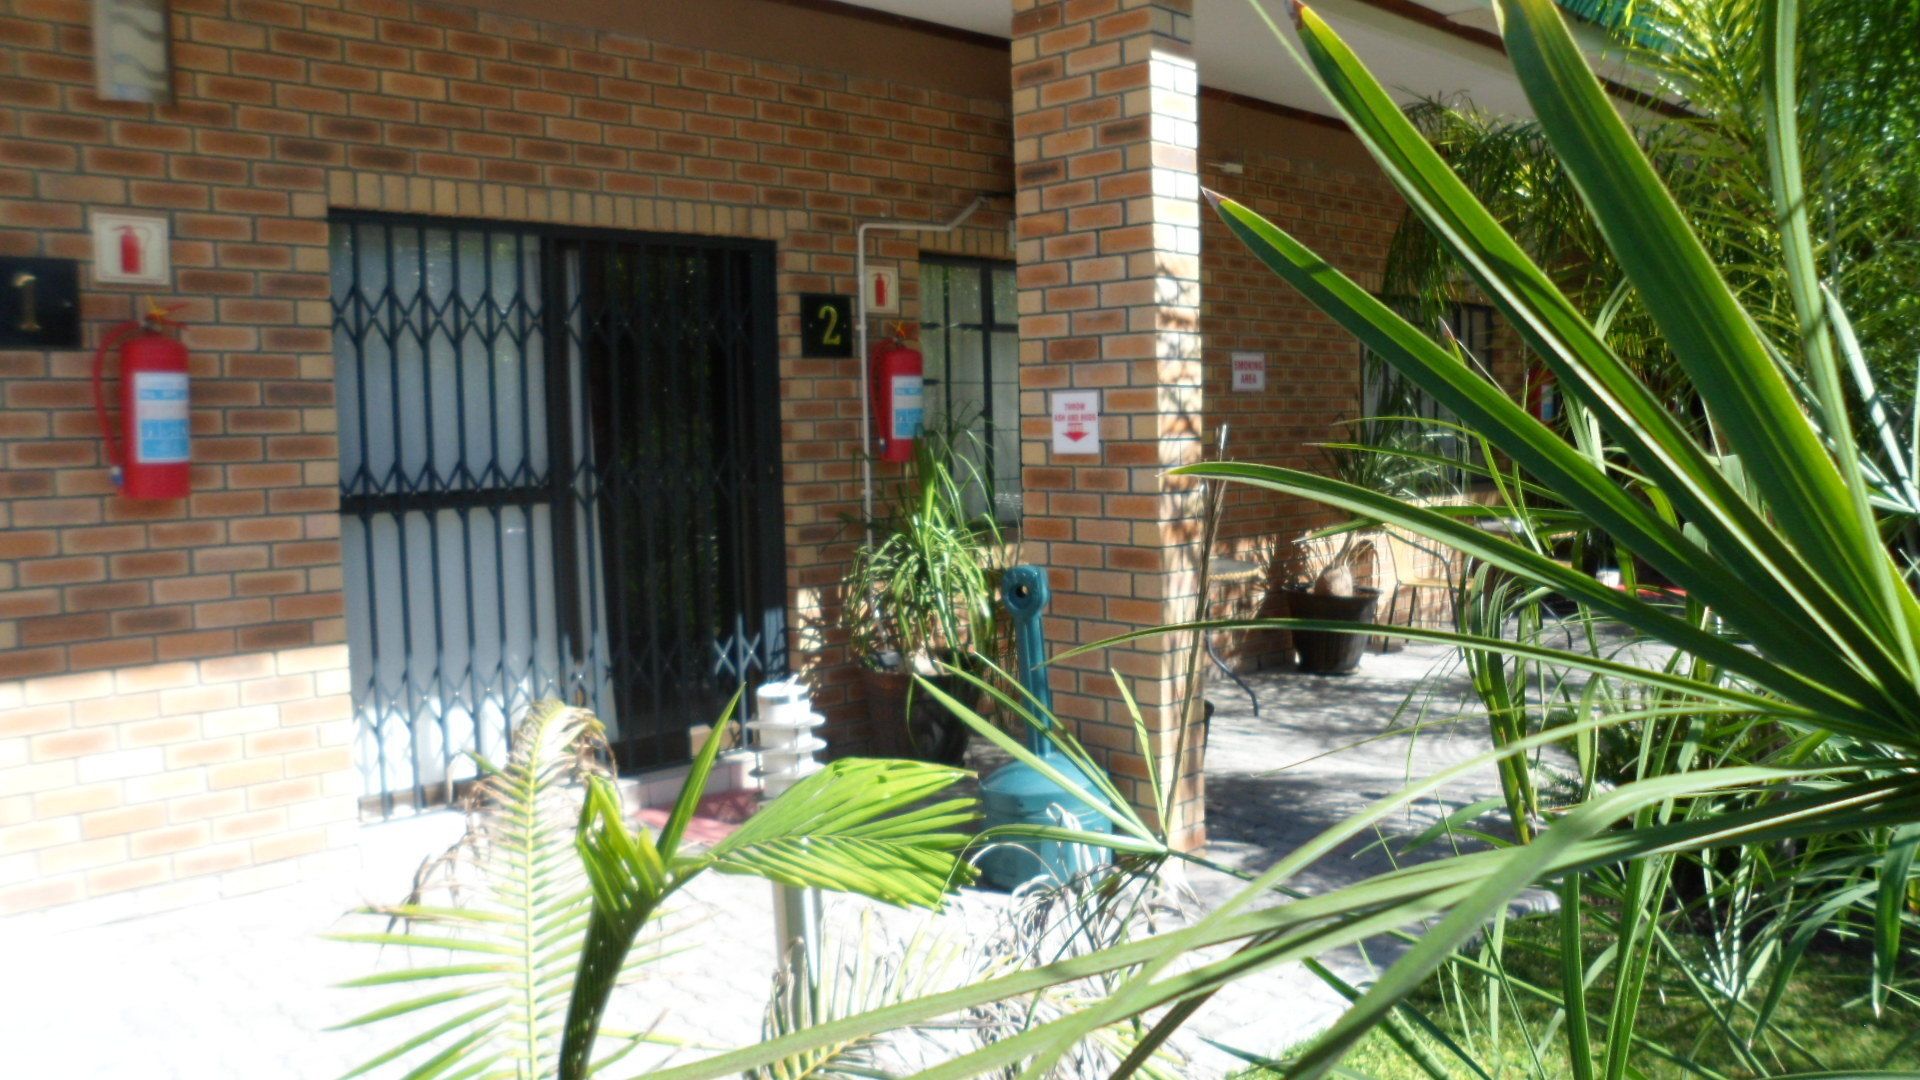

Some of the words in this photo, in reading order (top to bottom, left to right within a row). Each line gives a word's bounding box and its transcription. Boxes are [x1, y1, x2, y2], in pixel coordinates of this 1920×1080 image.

[11, 272, 41, 331] 1
[818, 305, 841, 345] 2
[1234, 361, 1264, 371] SMOKING
[1240, 374, 1257, 384] AREA
